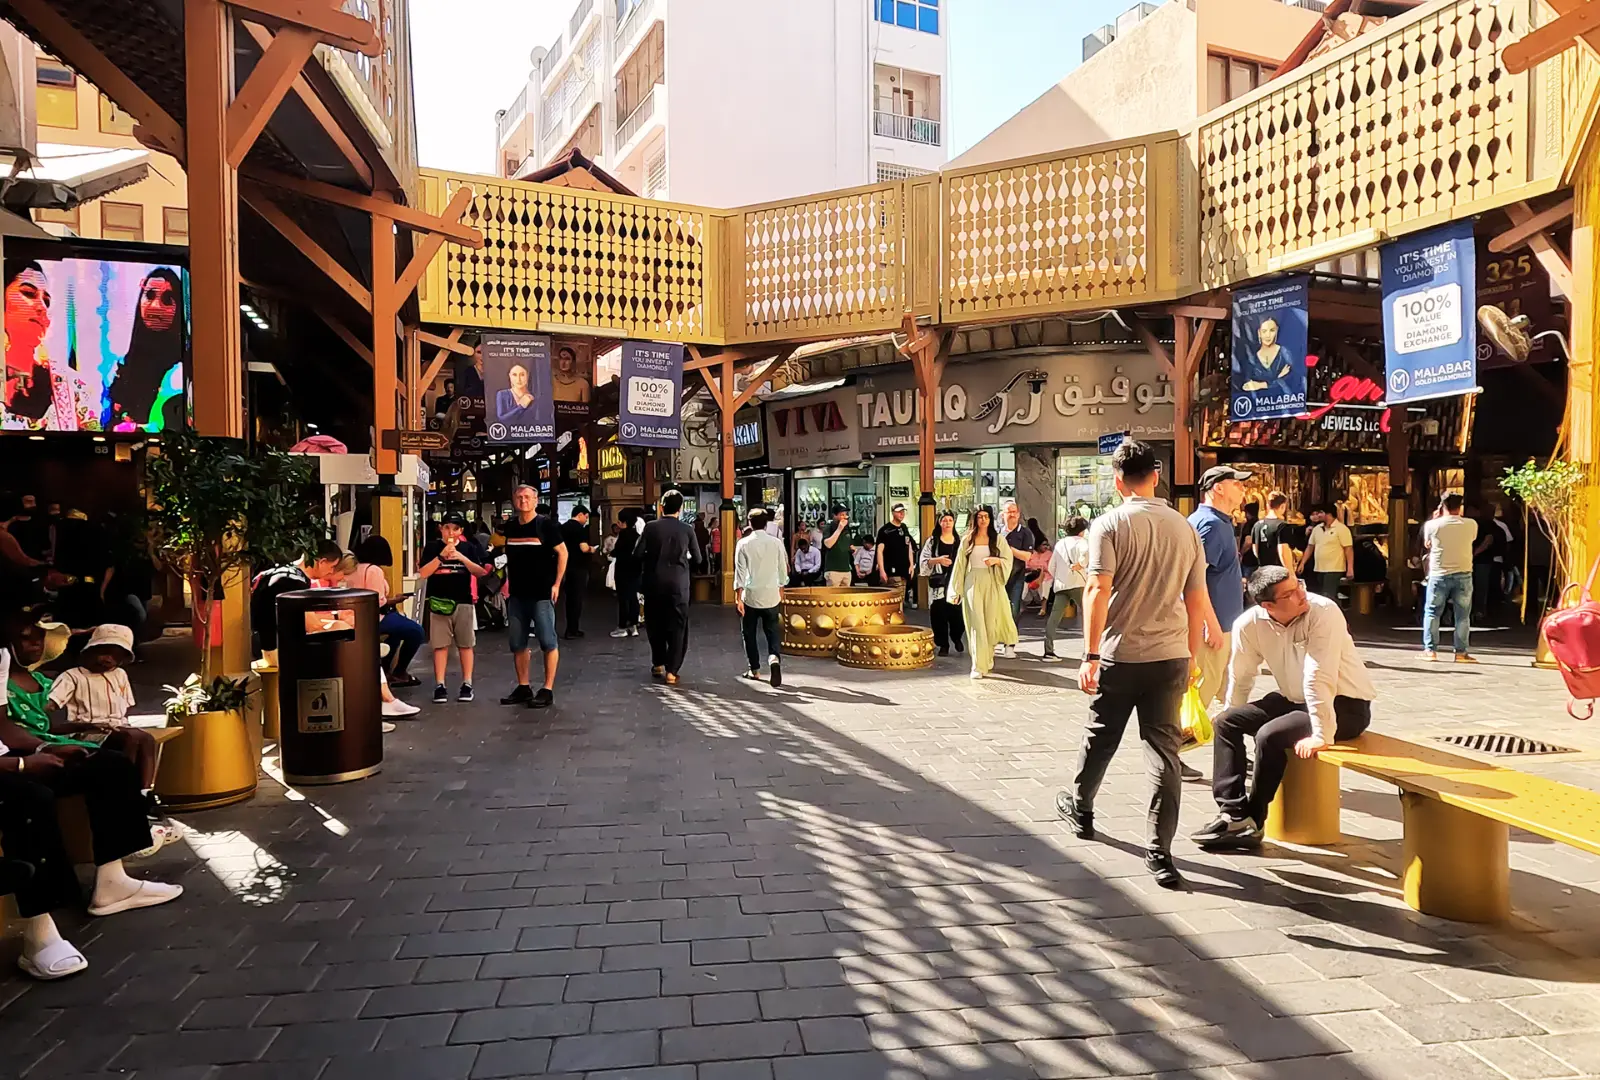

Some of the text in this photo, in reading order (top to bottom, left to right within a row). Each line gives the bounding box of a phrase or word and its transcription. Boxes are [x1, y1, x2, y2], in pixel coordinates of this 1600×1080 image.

[1399, 240, 1451, 265] IT'S TIME
[1394, 251, 1457, 276] YOU INVEST IN
[1485, 255, 1531, 282] 325
[1402, 262, 1450, 283] DIAMONDS
[1254, 296, 1284, 308] IT'S TIME
[1402, 292, 1451, 318] 100%
[1413, 312, 1442, 325] VALUE
[1406, 324, 1449, 339] DIAMOND
[1404, 331, 1452, 348] EXCHANGE
[635, 349, 670, 360] IT'S TIME
[636, 363, 668, 372] DIAMONDS
[1414, 360, 1472, 379] MALABAR
[863, 377, 875, 388] AL
[1414, 376, 1432, 386] GOLD
[1437, 370, 1472, 383] DIAMONDS
[635, 381, 668, 394] 100%
[1255, 392, 1305, 406] MALABAR
[634, 406, 668, 414] EXCHANGE
[1256, 404, 1270, 412] GOLD
[1275, 402, 1305, 411] DIAMONDS
[771, 400, 849, 438] VIVA
[1321, 415, 1380, 432] JEWELS LLC
[510, 425, 554, 433] MALABAR
[640, 426, 678, 435] MALABAR
[877, 432, 959, 447] JEWELLE L.L.C
